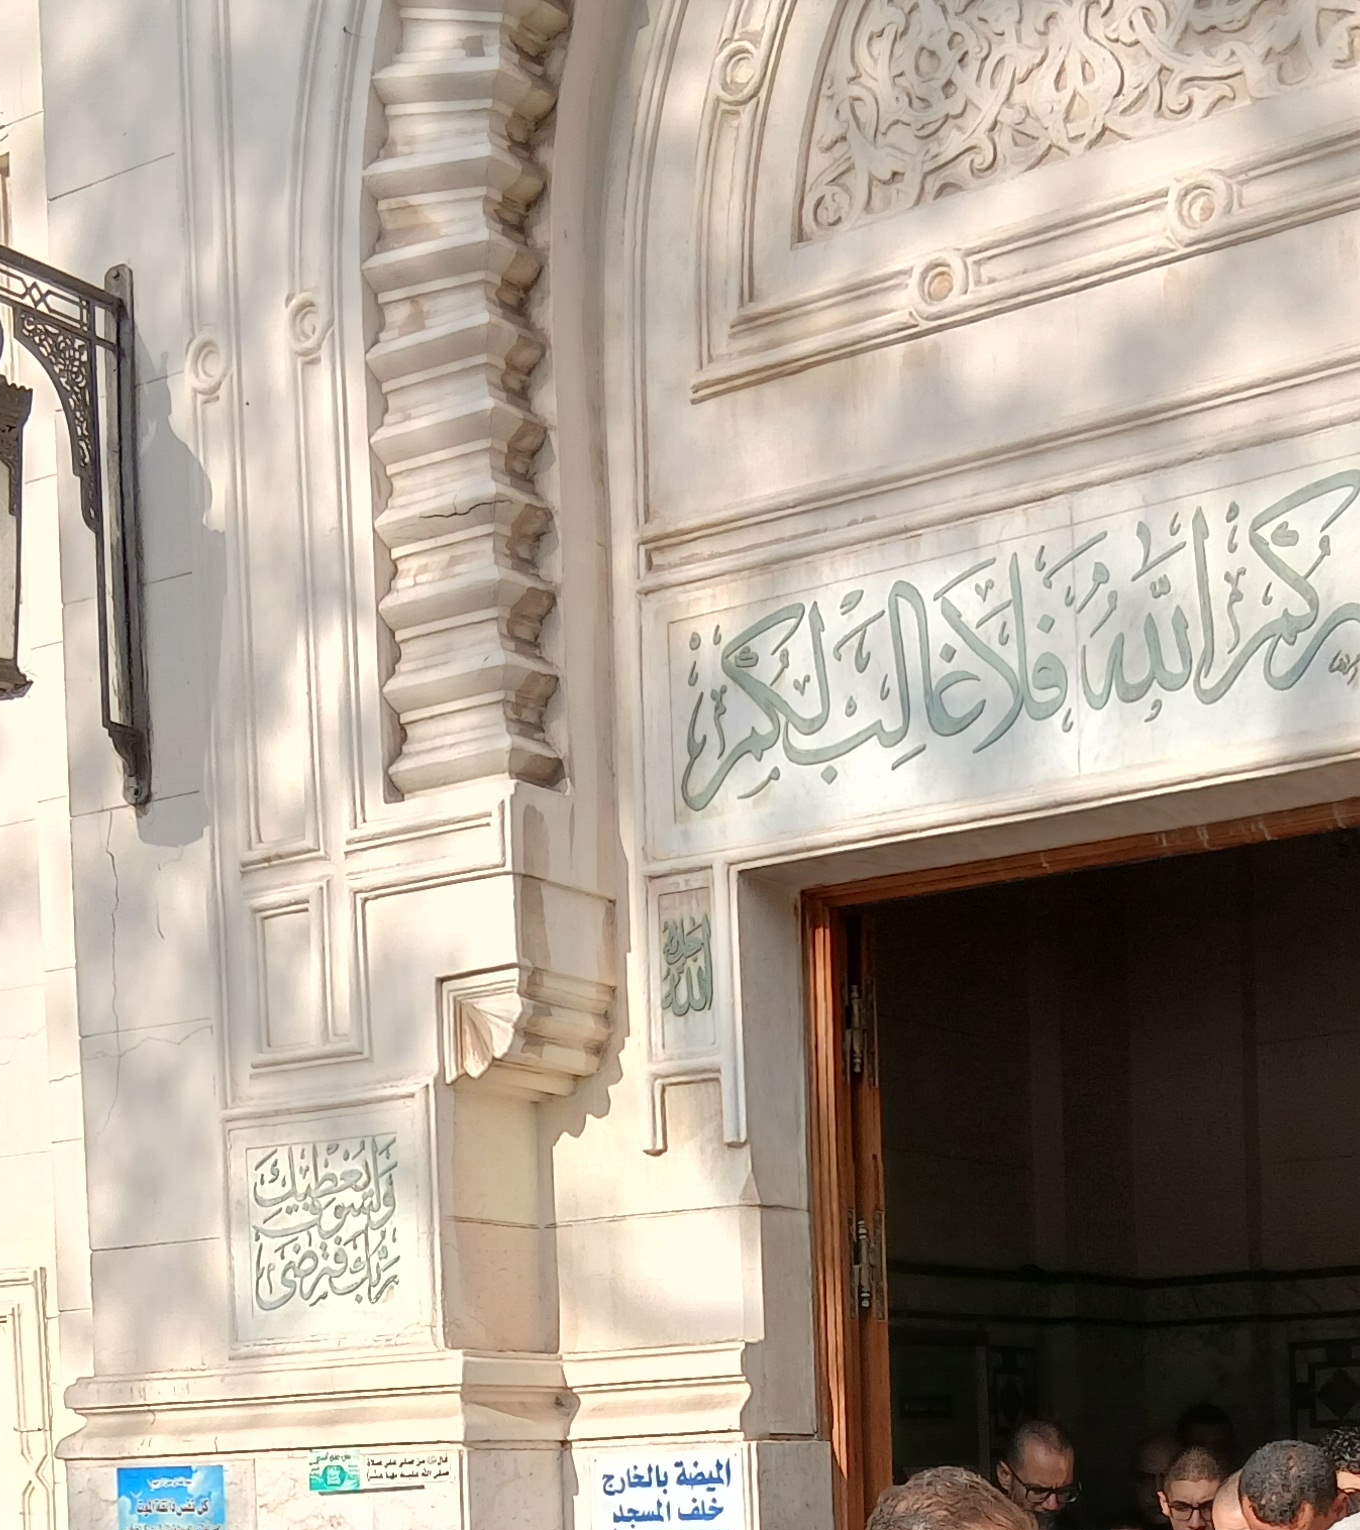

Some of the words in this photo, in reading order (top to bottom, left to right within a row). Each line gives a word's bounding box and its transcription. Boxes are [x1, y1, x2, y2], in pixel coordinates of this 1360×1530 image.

[602, 1464, 669, 1496] بالخارج
[675, 1458, 732, 1492] الميضة
[613, 1498, 671, 1529] المسجد
[678, 1497, 724, 1521] خلف
